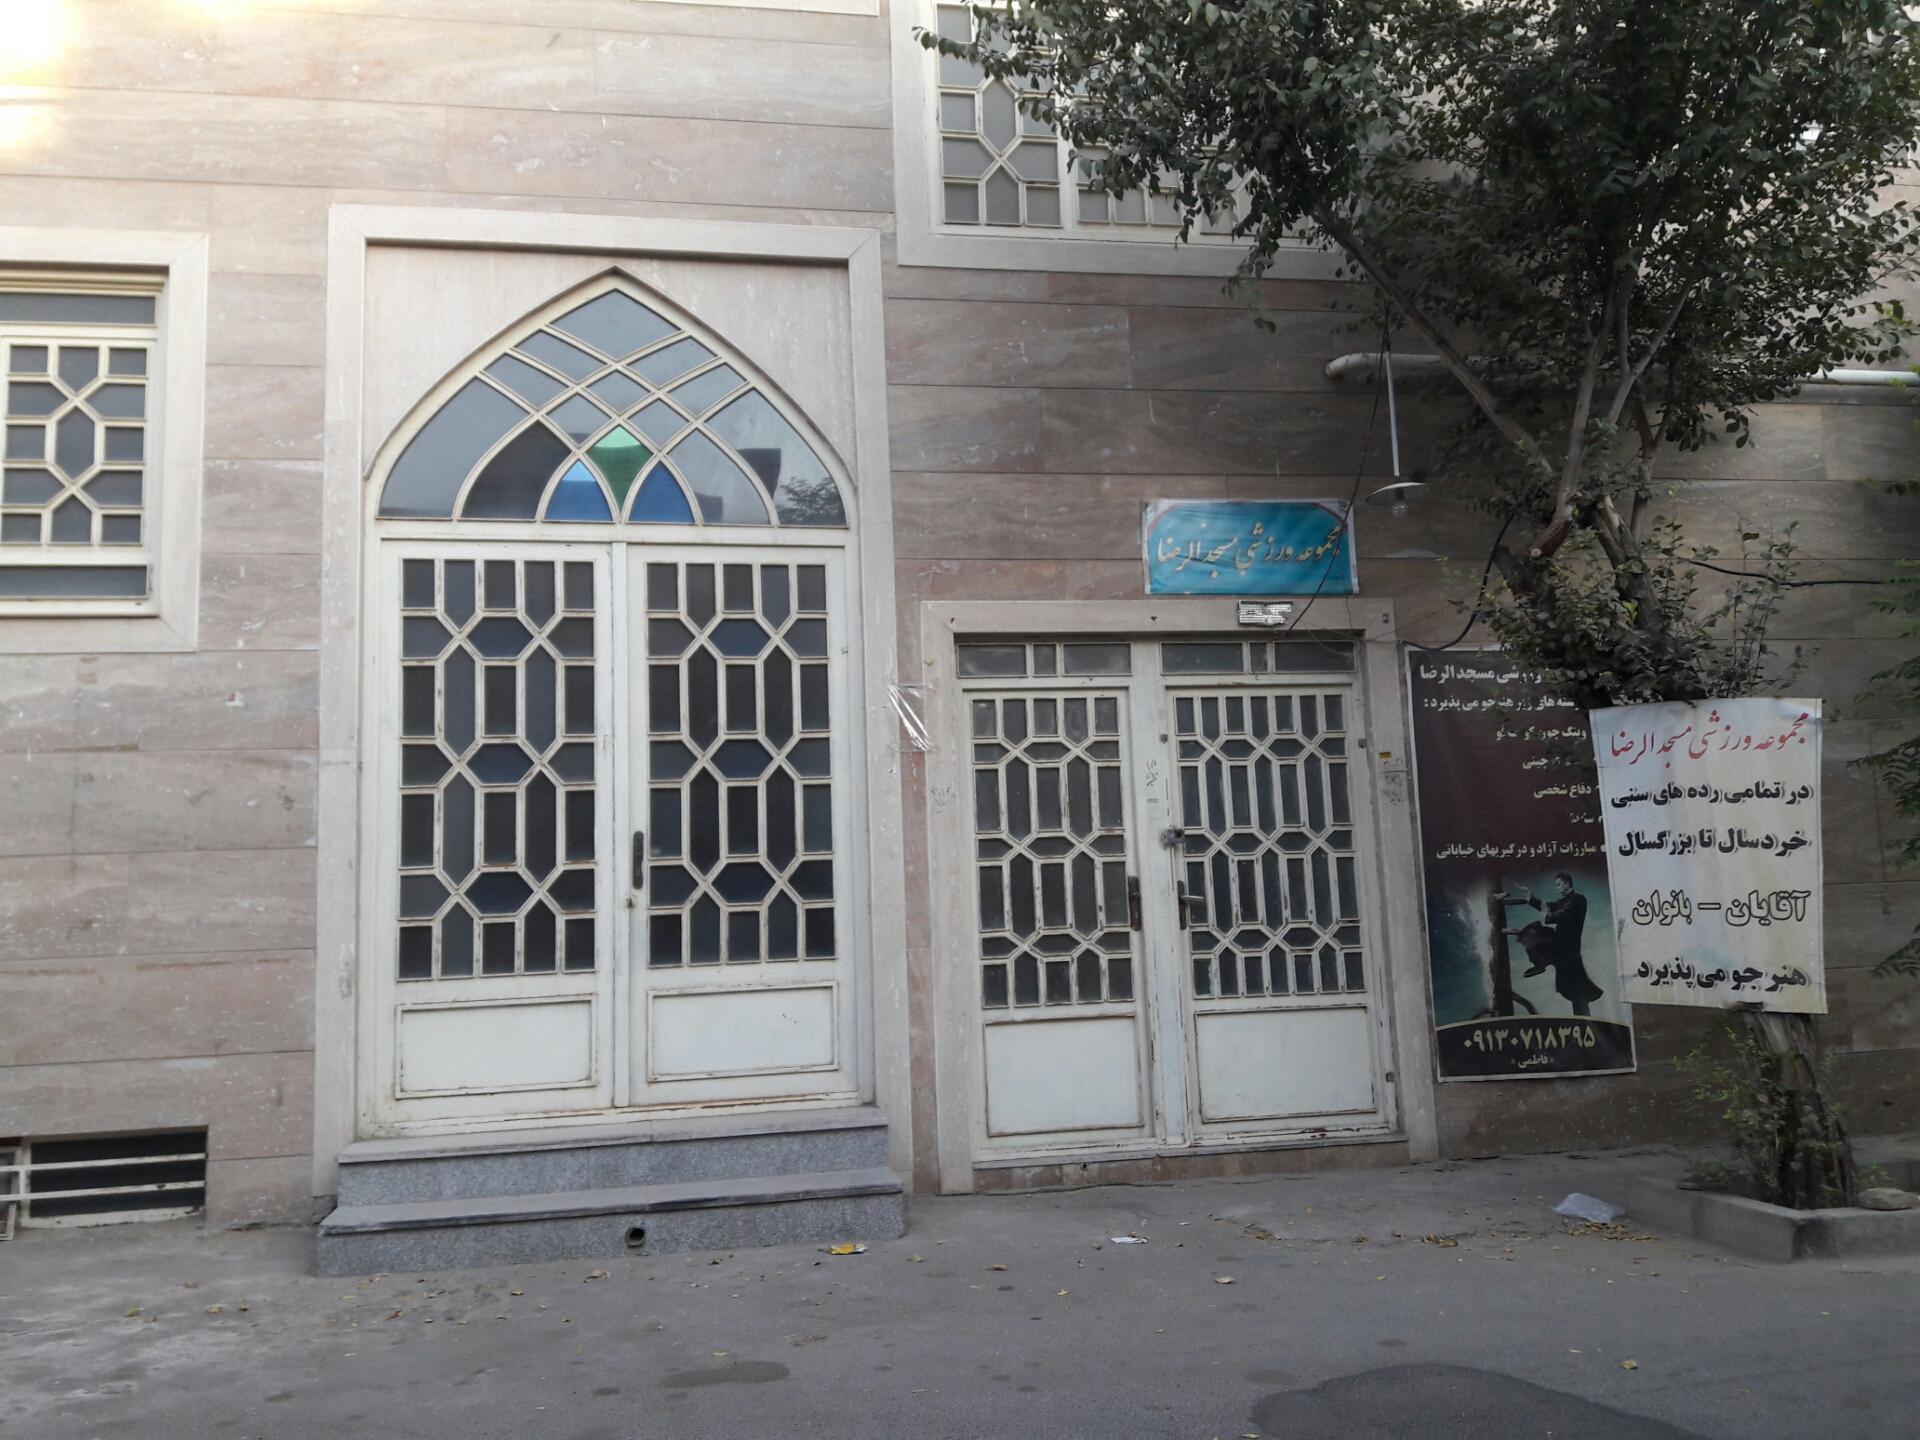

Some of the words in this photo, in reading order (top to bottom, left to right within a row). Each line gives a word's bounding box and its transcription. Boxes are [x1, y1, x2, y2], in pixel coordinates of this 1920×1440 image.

[1157, 535, 1201, 572] الرضا
[1235, 521, 1293, 576] ورزشی
[1296, 525, 1342, 562] مجموعه
[1201, 535, 1239, 579] مسجد
[1419, 664, 1455, 684] الرضا
[1456, 667, 1495, 683] مسجد
[1461, 700, 1479, 711] می
[1688, 709, 1753, 760] ورزشی
[1753, 712, 1810, 751] مجموعه
[1611, 730, 1655, 765] الرضا
[1655, 725, 1693, 768] مسجد
[1522, 756, 1549, 770] چینی
[1533, 783, 1568, 799] شخصی
[1569, 782, 1592, 798] دفاع
[1610, 787, 1650, 809] سنی
[1652, 782, 1684, 805] های
[1687, 784, 1721, 804] رده
[1723, 780, 1783, 804] تمامی
[1784, 784, 1815, 805] در
[1536, 840, 1558, 857] آزاد
[1559, 841, 1598, 857] مبارزات
[1618, 830, 1695, 857] بزرگسال
[1698, 828, 1714, 849] تا
[1717, 827, 1809, 857] خردسال
[1436, 843, 1474, 859] خیابانی
[1632, 889, 1693, 926] بانوان
[1725, 889, 1812, 927] آقایان
[1636, 956, 1694, 989] پذیرد
[1696, 966, 1728, 989] می
[1463, 1024, 1596, 1052] ۰۹۱۳۰۷۱۸۳۹۵
